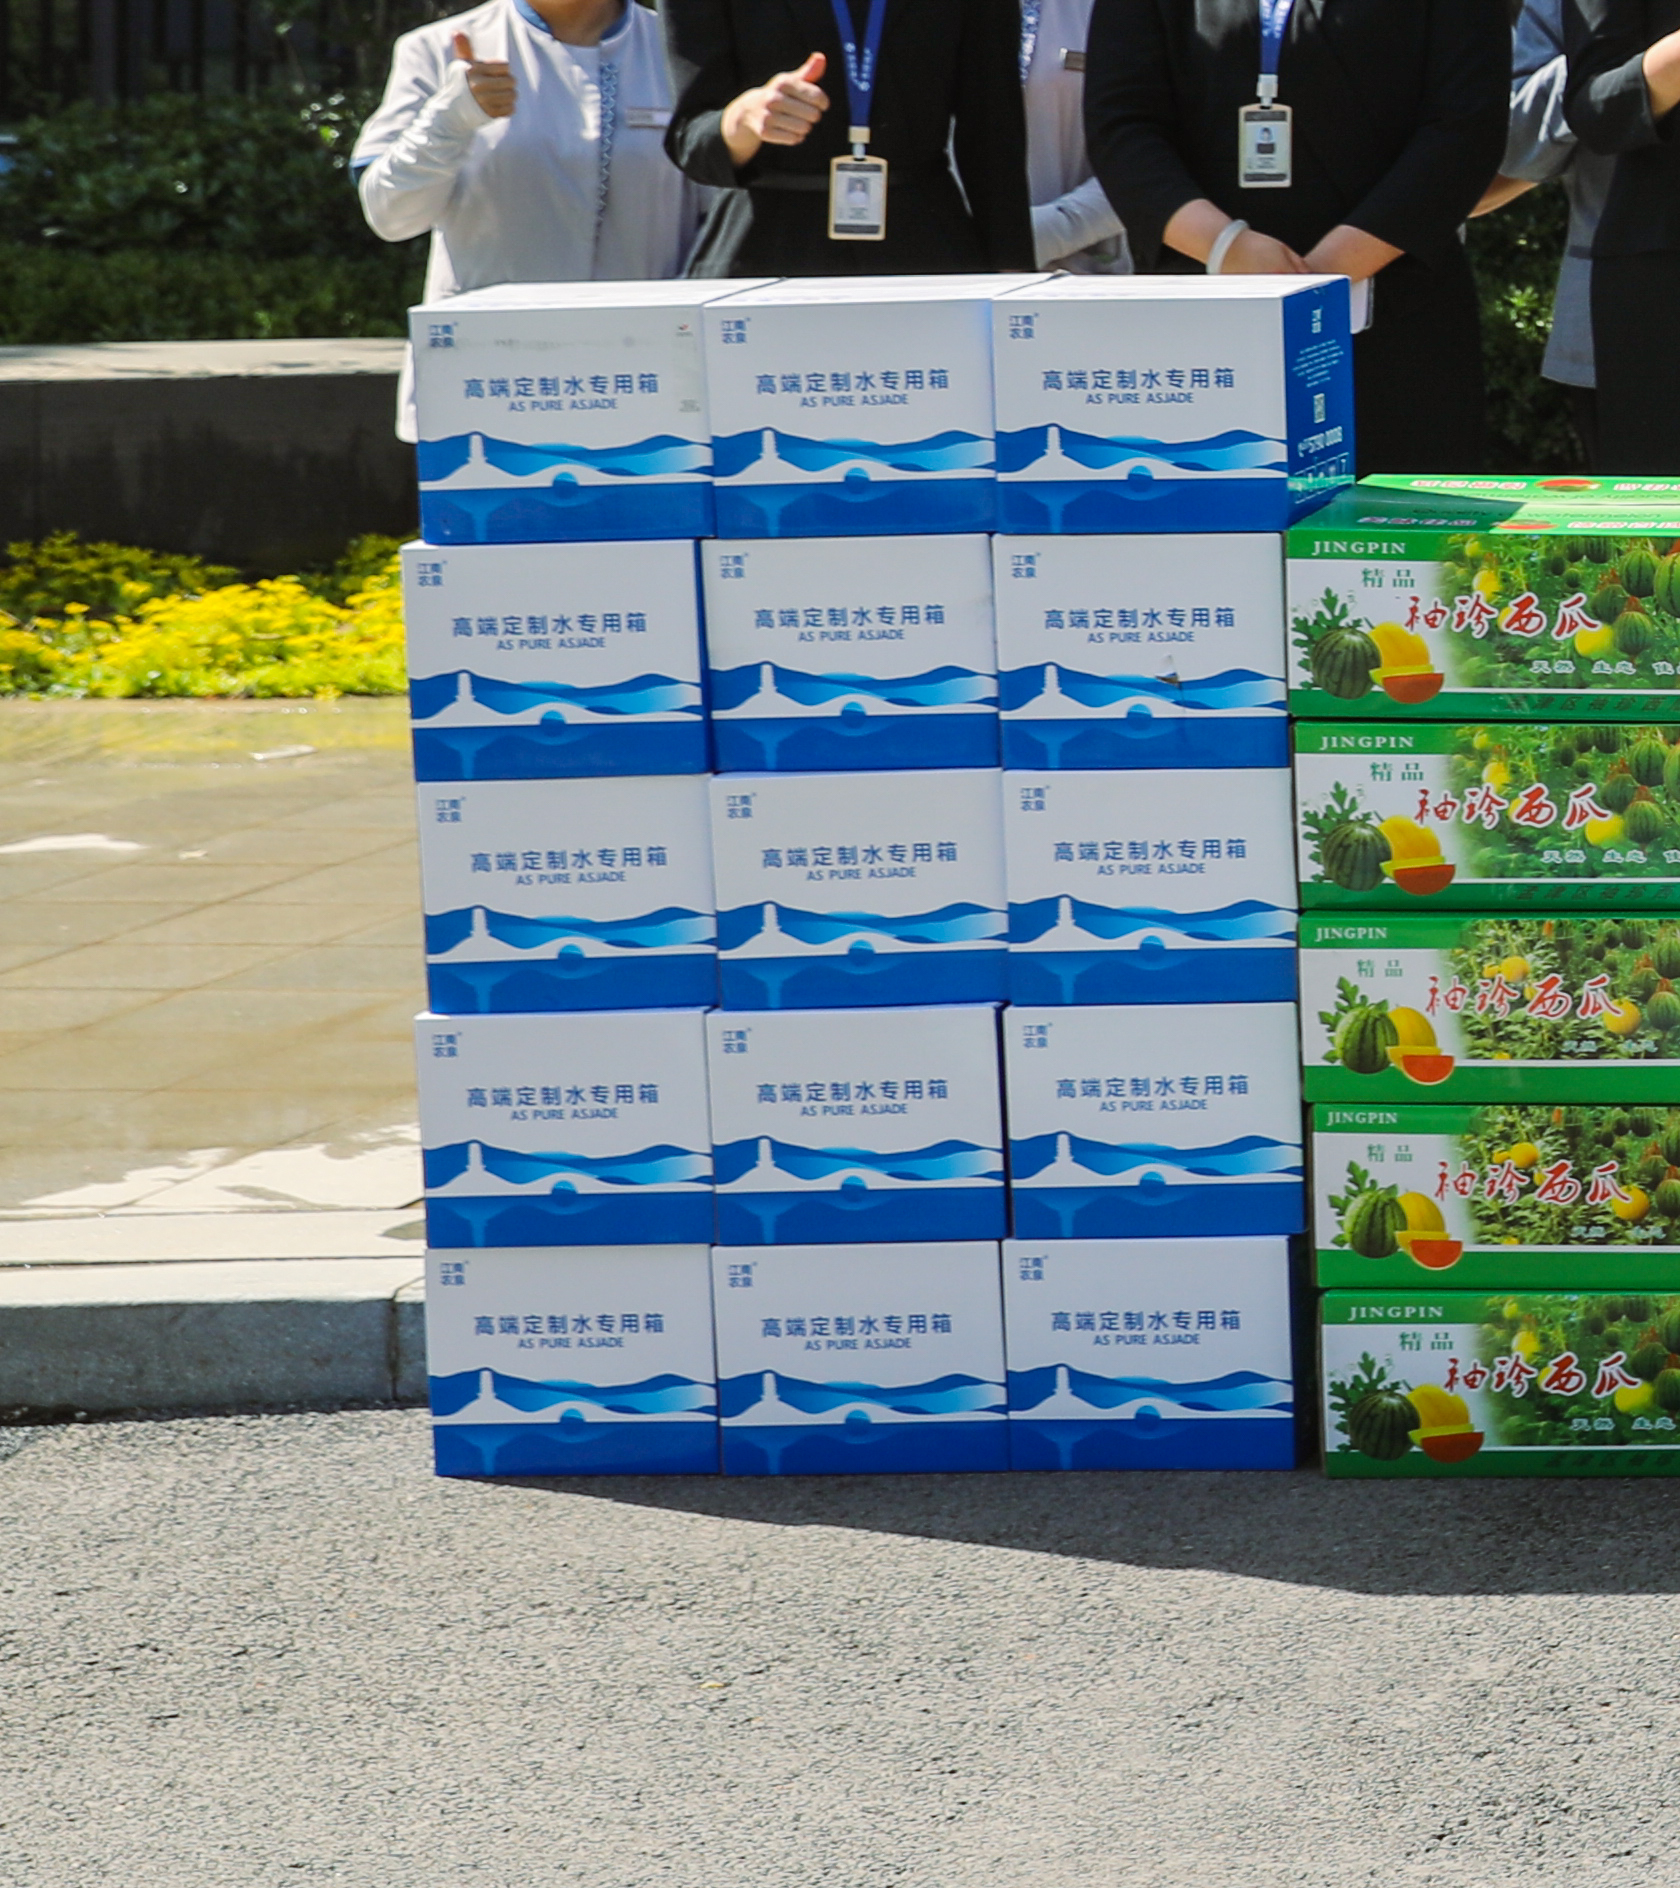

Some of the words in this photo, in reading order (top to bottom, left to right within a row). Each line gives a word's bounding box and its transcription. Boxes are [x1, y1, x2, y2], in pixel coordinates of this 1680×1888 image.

[464, 371, 659, 400] 高端定制水专用箱
[755, 366, 950, 394] 高端定制水专用箱
[1042, 365, 1235, 392] 高端定制水专用箱
[508, 401, 526, 412] AS
[530, 399, 563, 412] PURE
[569, 398, 617, 410] ASJADE
[1085, 393, 1103, 405] AS
[1107, 392, 1141, 405] PURE
[1146, 392, 1193, 404] ASJADE
[1312, 539, 1407, 557] JINGPIN
[1361, 568, 1417, 589] 精品
[1405, 592, 1602, 638] 袖珍西瓜
[1320, 734, 1415, 751] JINGPIN
[1370, 761, 1425, 783] 精品
[1414, 783, 1611, 827] 袖珍西瓜
[470, 845, 667, 875] 高端定制水专用箱
[761, 840, 957, 871] 高端定制水专用箱
[1052, 837, 1247, 865] 高端定制水专用箱
[1426, 975, 1625, 1016] 袖珍西瓜
[1435, 1161, 1633, 1202] 袖珍西瓜
[474, 1312, 664, 1340] 高端定制水专用箱
[761, 1311, 952, 1339] 高端定制水专用箱
[1050, 1308, 1241, 1335] 高端定制水专用箱
[1444, 1353, 1642, 1395] 袖珍西瓜
